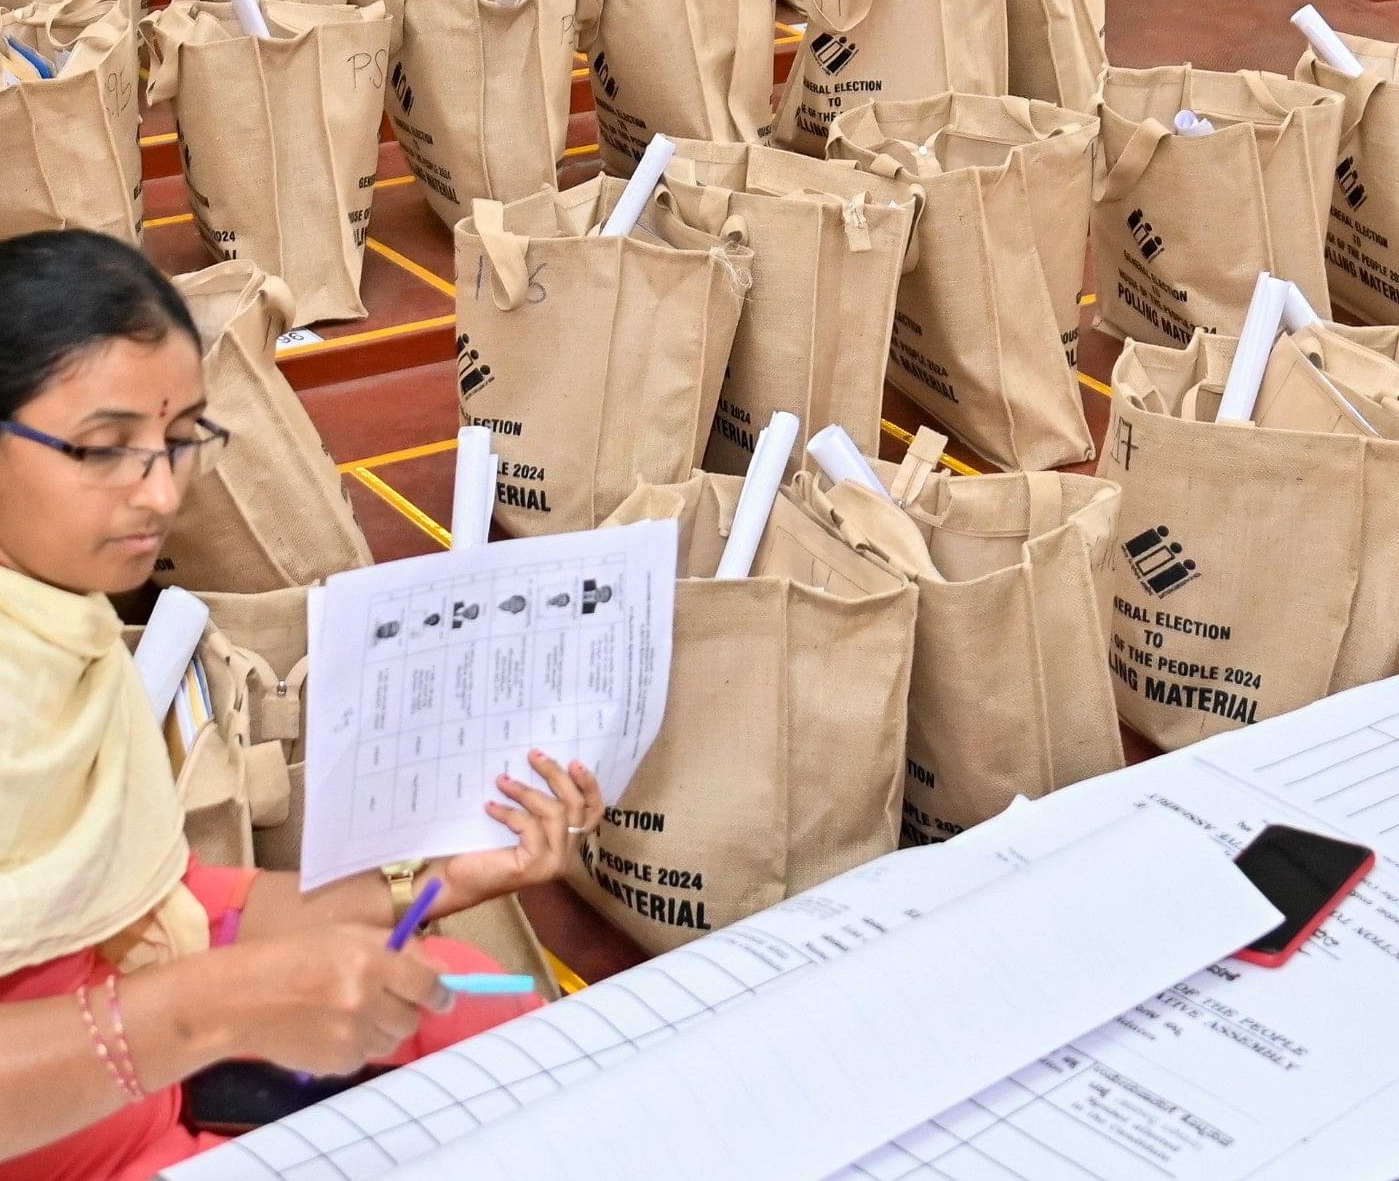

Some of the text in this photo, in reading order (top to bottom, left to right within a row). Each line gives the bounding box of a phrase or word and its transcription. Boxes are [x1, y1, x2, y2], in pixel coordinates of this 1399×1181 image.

[827, 96, 842, 107] TO
[833, 80, 883, 94] ELECTION
[1352, 233, 1362, 246] TO
[1354, 223, 1389, 249] ELECTION
[1346, 241, 1361, 261] THE
[1360, 249, 1389, 278] PEOPLE
[1117, 281, 1192, 349] POLLING MATE
[512, 462, 546, 482] 2024
[496, 482, 552, 512] ERIAL
[1143, 629, 1164, 649] TO
[1155, 611, 1231, 641] ELECTION
[1114, 637, 1262, 691] OF THE PEOPLE 2024
[1108, 649, 1259, 725] LING MATERIAL
[604, 805, 665, 833] ECTION
[657, 866, 703, 891] 2024
[1173, 980, 1309, 1057] OF THE PEOPLE
[1204, 1018, 1302, 1072] ASSEMBLY
